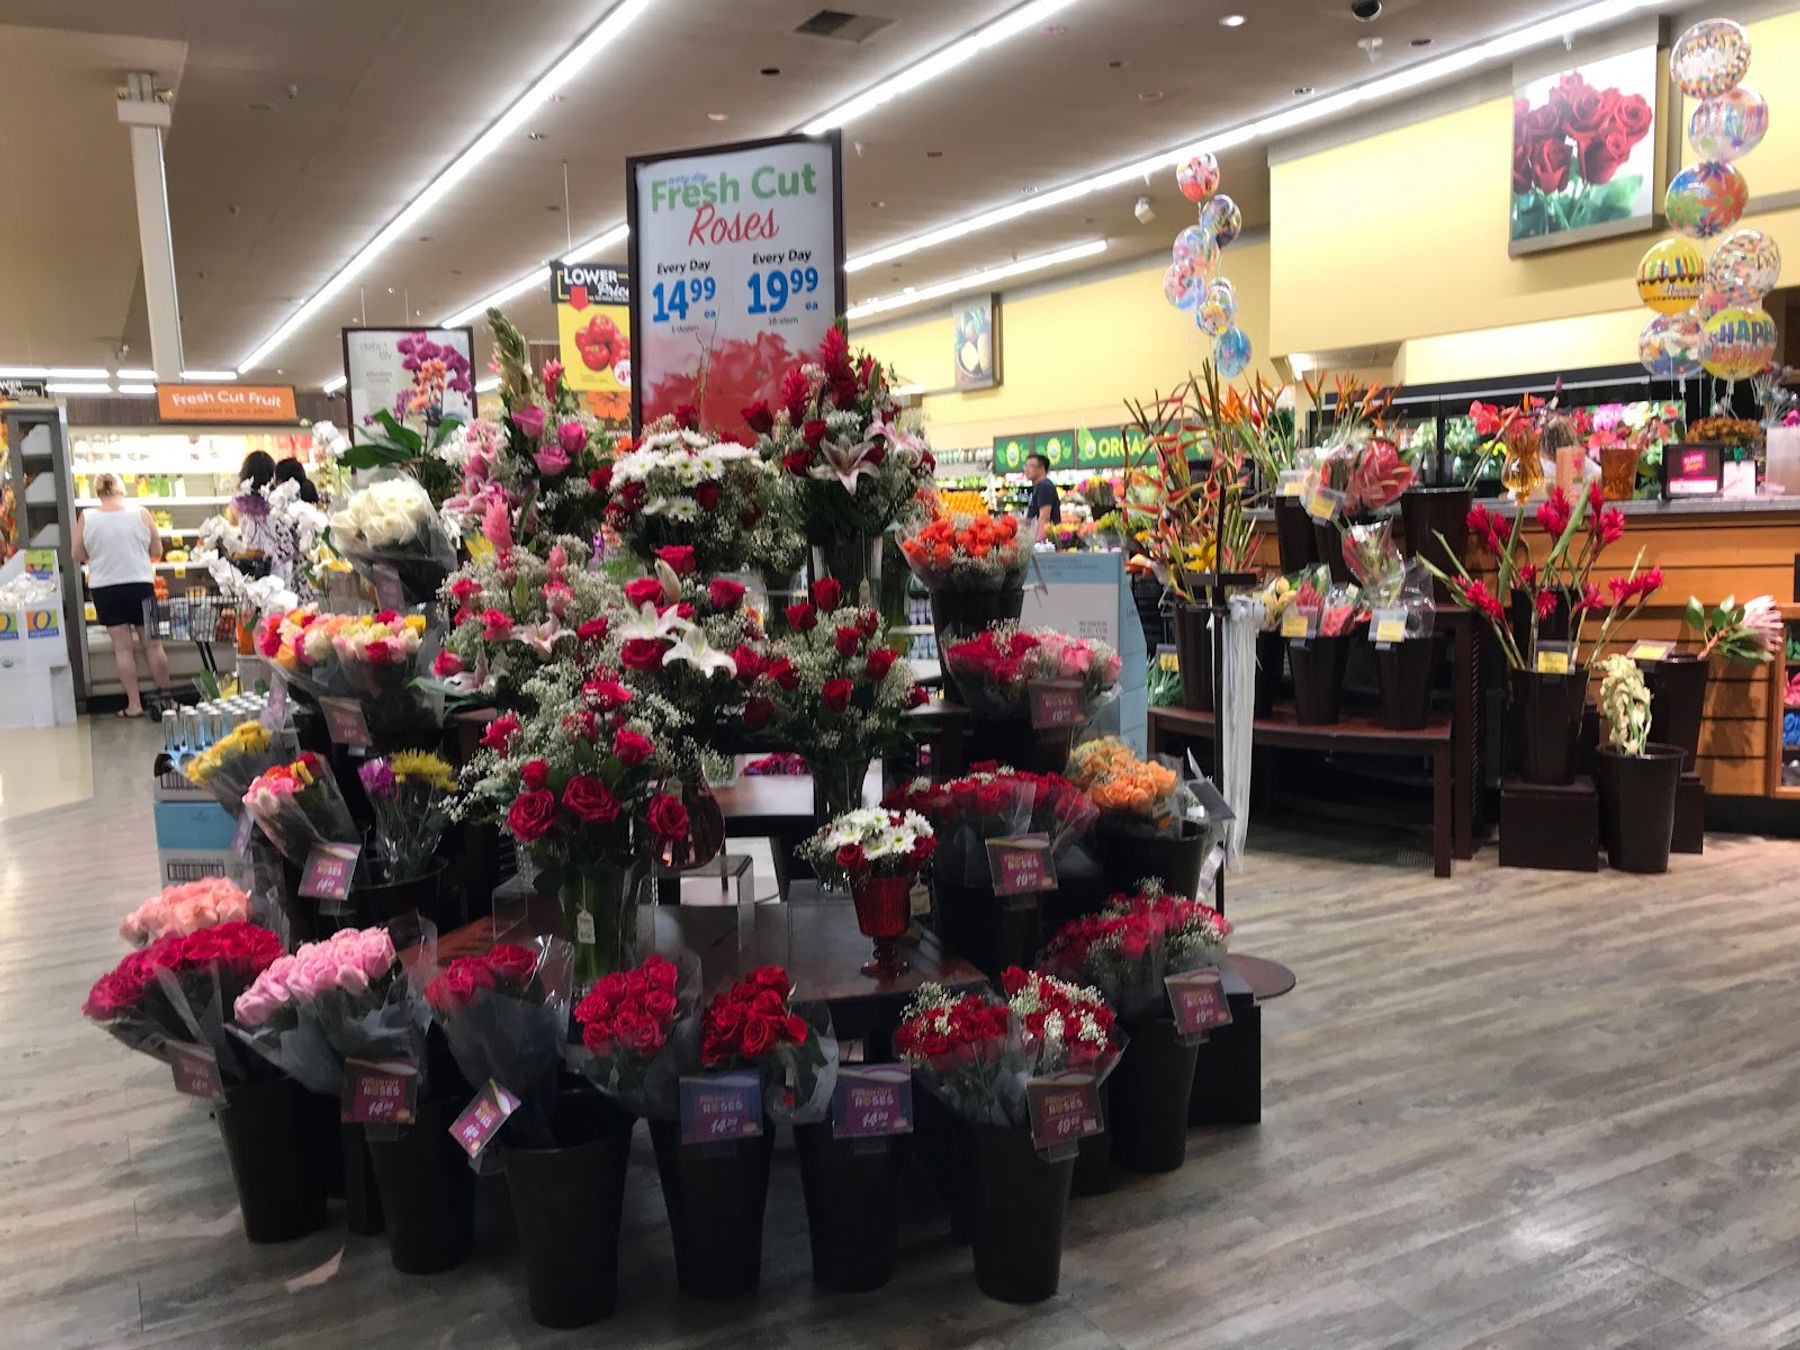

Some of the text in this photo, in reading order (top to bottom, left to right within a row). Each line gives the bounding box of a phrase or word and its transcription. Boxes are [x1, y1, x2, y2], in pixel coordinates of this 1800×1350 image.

[651, 163, 817, 213] Fresh Cut
[688, 203, 779, 247] Roses
[656, 258, 711, 275] Every Day
[752, 249, 812, 266] Every Day
[563, 267, 617, 286] LOWER
[172, 390, 281, 408] Fresh Cut Fruit
